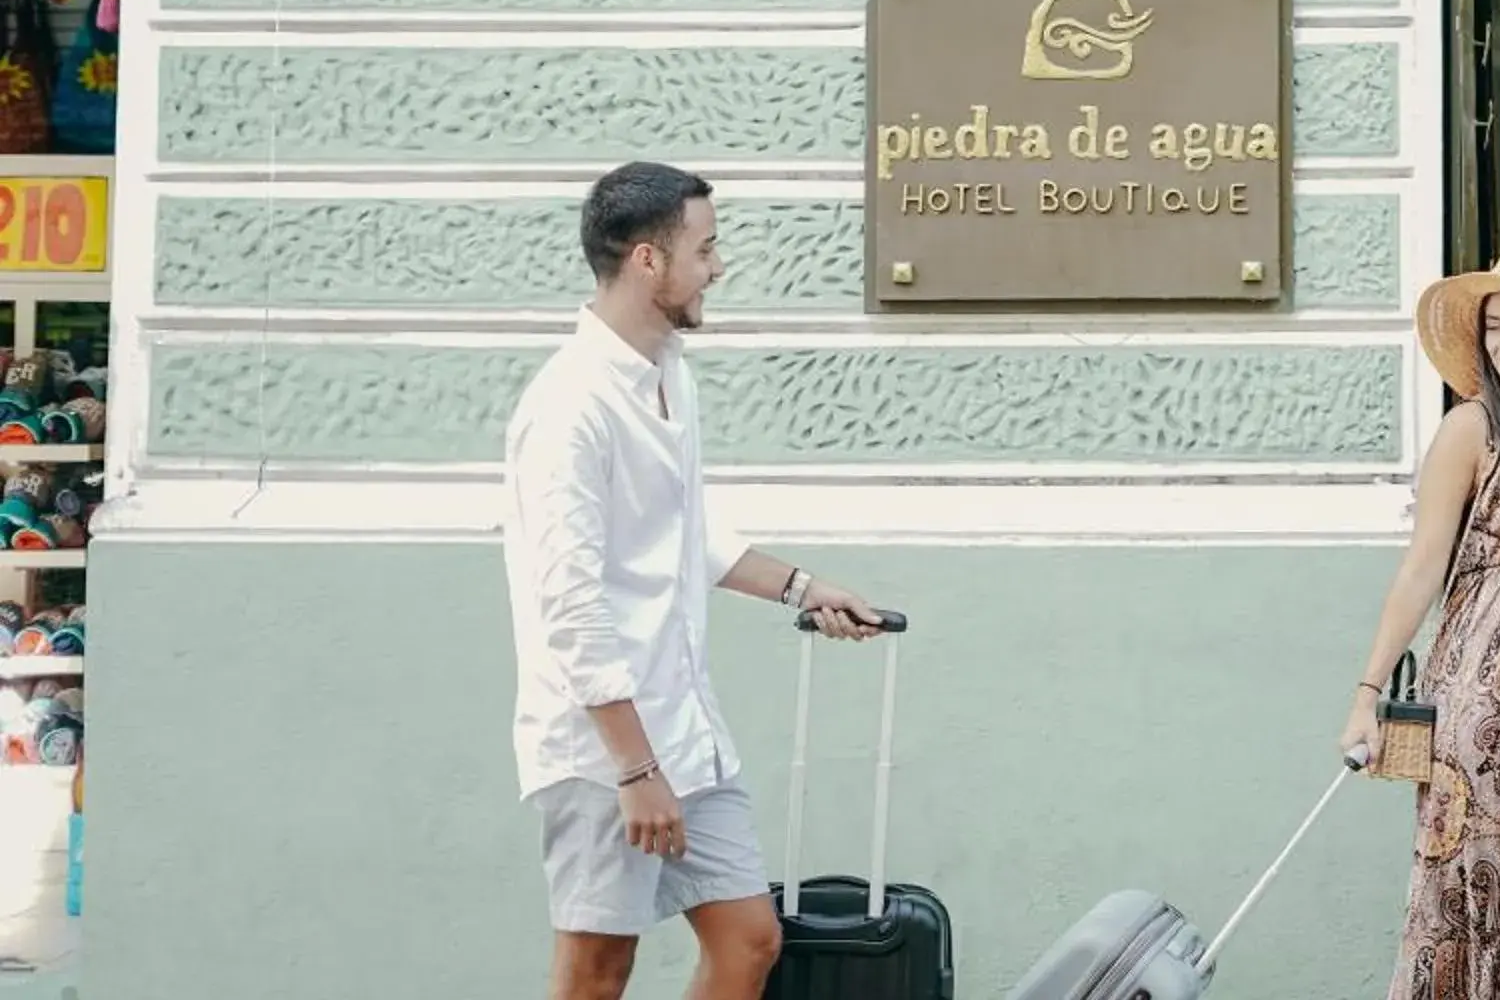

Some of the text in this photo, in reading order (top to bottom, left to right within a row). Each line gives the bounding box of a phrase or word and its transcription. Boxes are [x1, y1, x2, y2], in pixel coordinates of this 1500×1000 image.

[877, 104, 1278, 180] piedra de agua
[901, 179, 1250, 215] HOTEL BOUTIQUE
